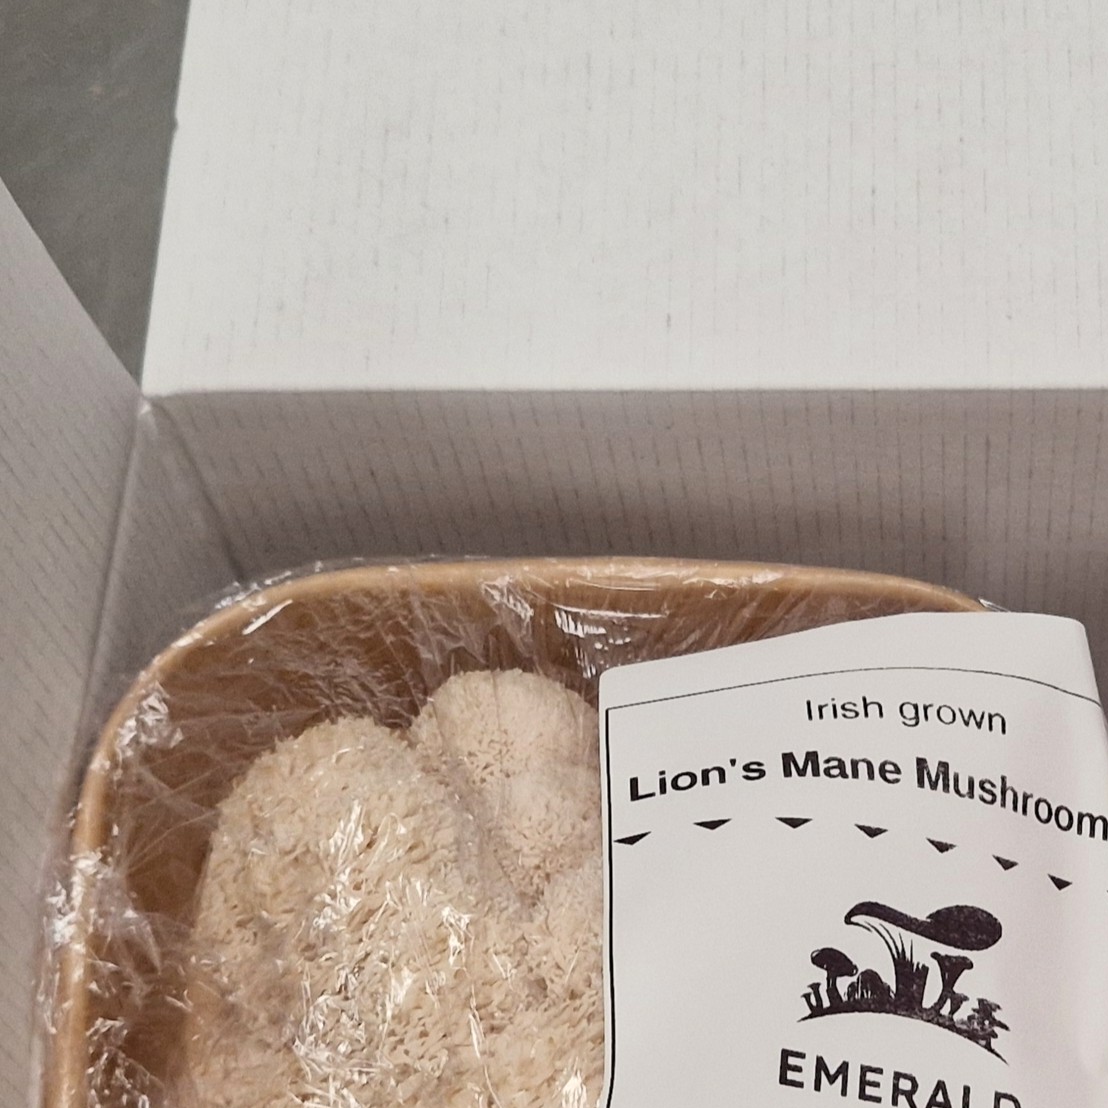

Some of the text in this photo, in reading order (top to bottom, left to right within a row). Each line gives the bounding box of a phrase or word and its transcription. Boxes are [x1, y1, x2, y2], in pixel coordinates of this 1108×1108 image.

[805, 695, 1007, 736] Irish grown
[629, 757, 767, 803] Lion's
[780, 749, 903, 785] Mane
